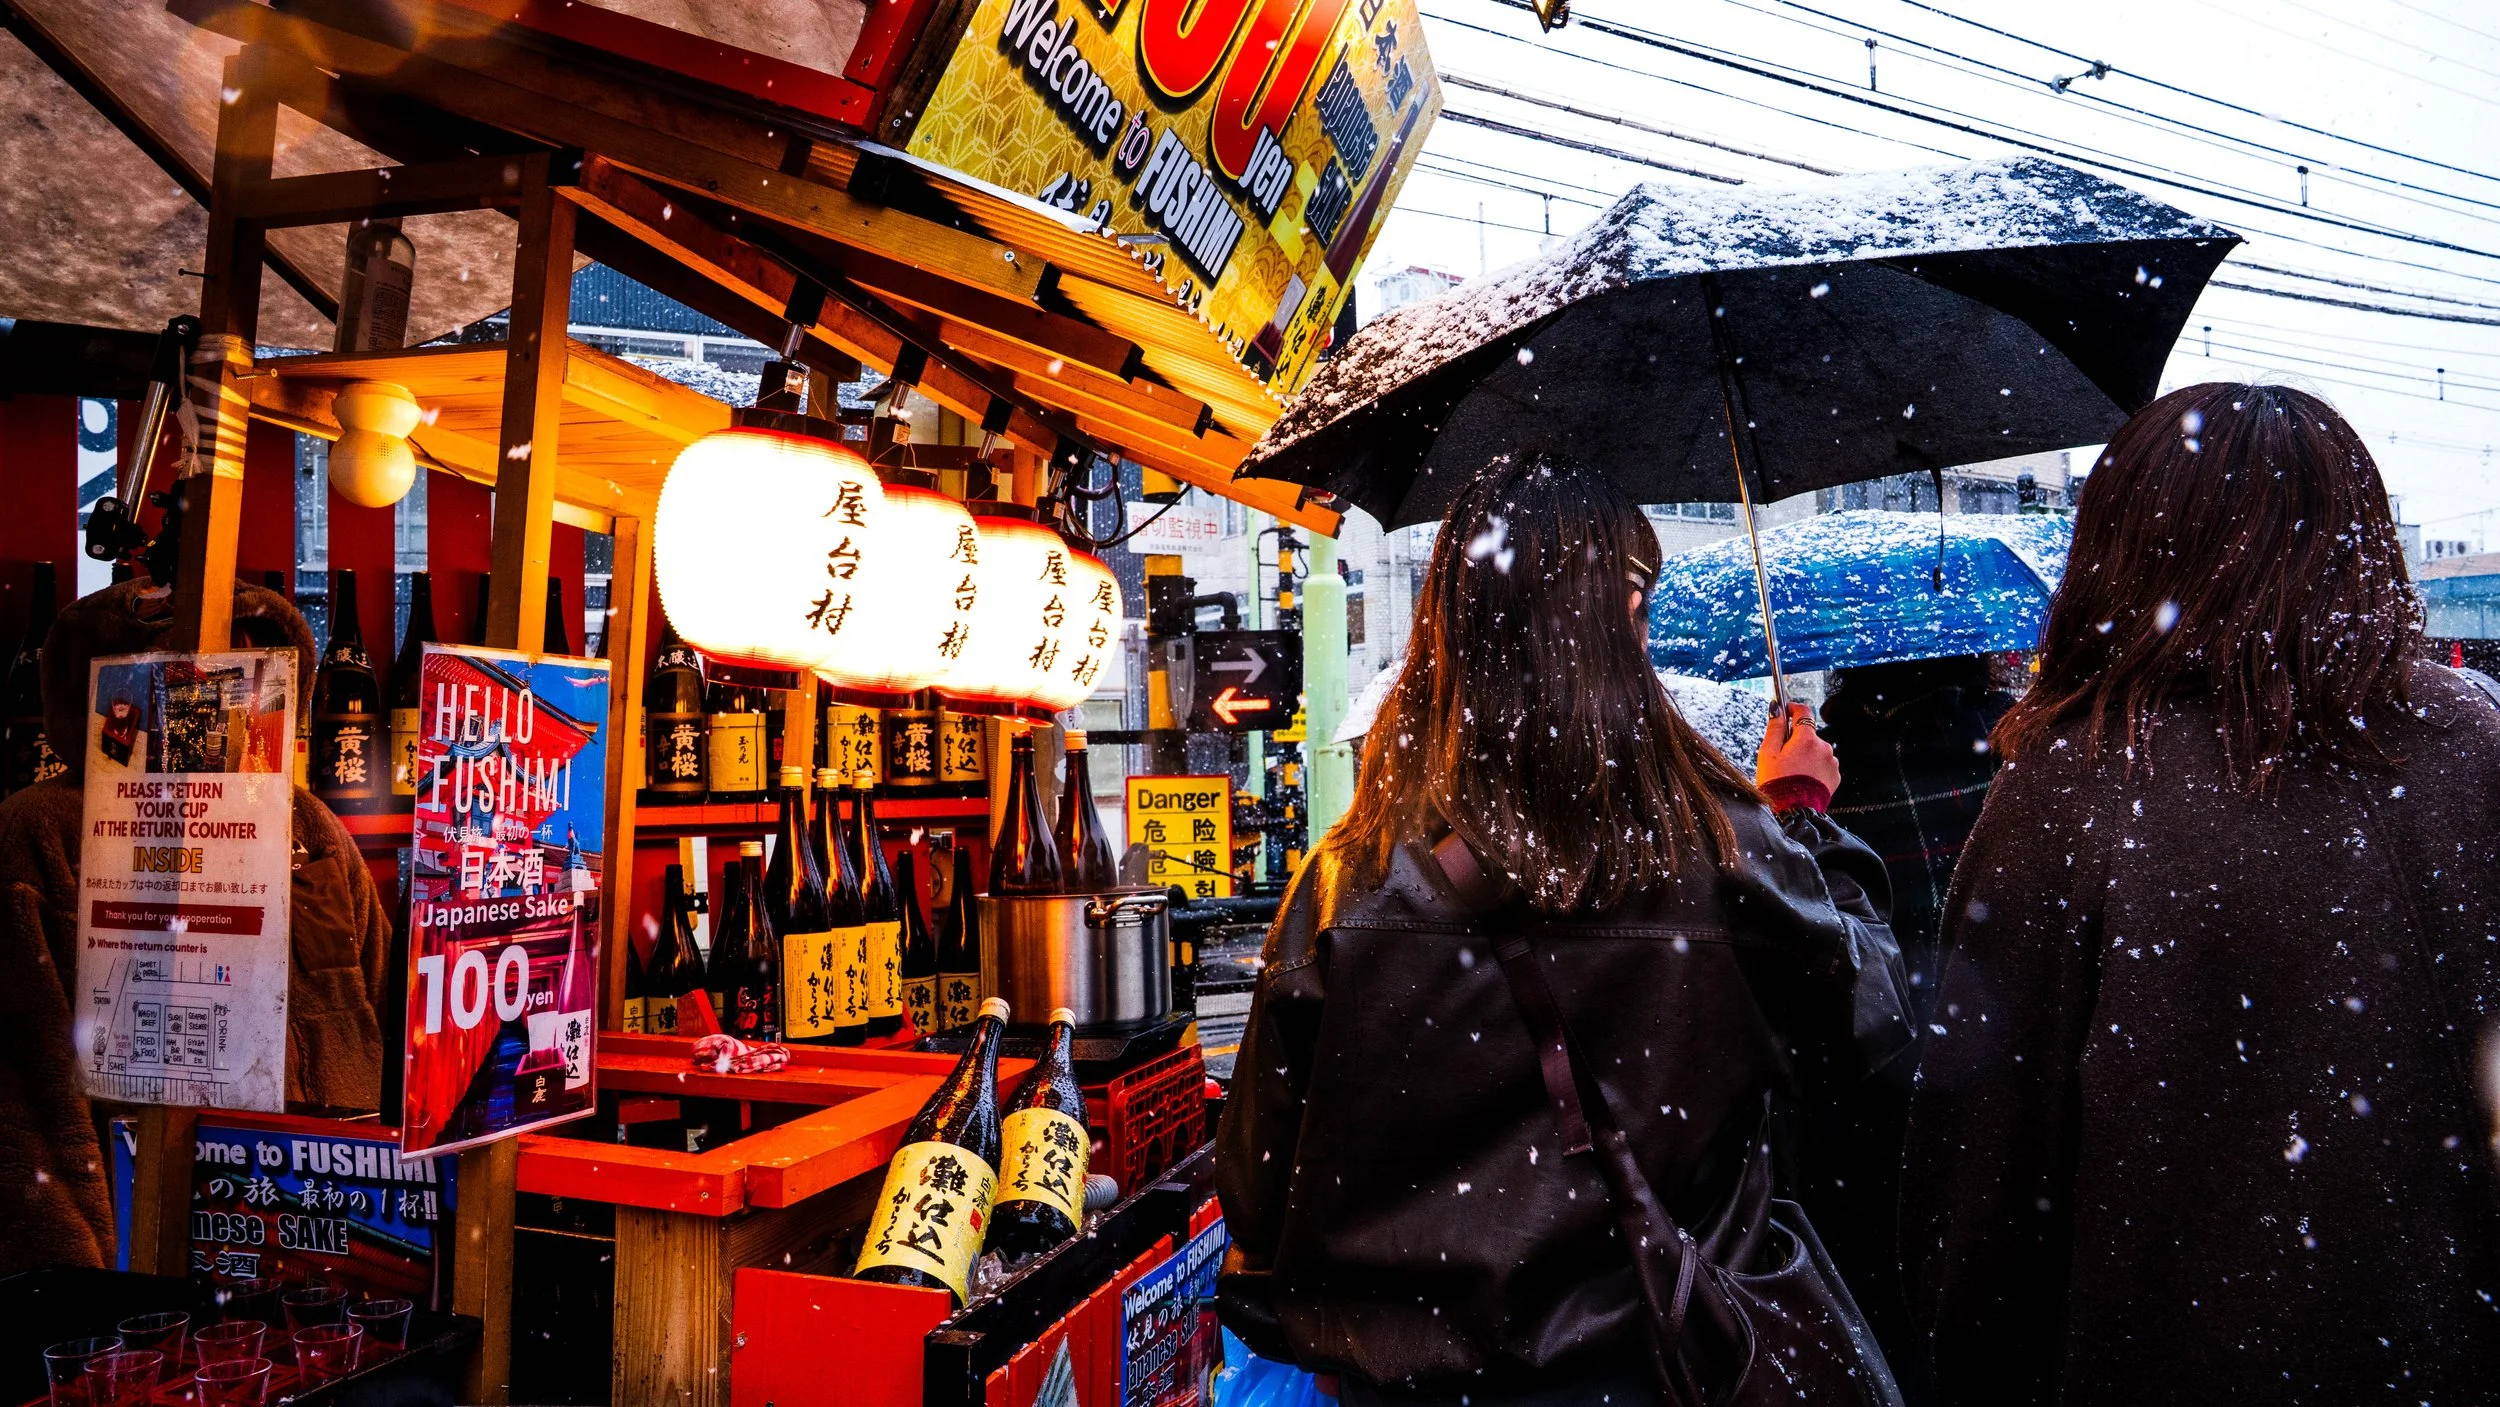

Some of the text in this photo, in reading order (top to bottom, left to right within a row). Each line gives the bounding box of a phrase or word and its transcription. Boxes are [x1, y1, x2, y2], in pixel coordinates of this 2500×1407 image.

[1004, 0, 1122, 143] Welcome
[1118, 110, 1150, 169] to
[1135, 127, 1244, 279] FUSHIMI
[1238, 125, 1293, 215] yen
[805, 480, 867, 635] 屋台村
[937, 524, 979, 660] 屋台村
[1028, 550, 1067, 672] 屋台村
[1071, 580, 1115, 686] 屋台村
[435, 682, 534, 744] HELLO
[334, 726, 370, 785] 黄桜
[670, 724, 700, 778] 黄桜
[738, 735, 750, 765] 玉乃光
[840, 735, 851, 778] からくち
[904, 722, 933, 773] 黄桜
[943, 733, 954, 775] からくち
[117, 782, 223, 799] PLEASE RETURN
[136, 802, 209, 818] YOUR CUP
[431, 755, 571, 814] FUSHIMI
[1138, 789, 1220, 812] Danger
[93, 821, 257, 840] AT THE RETURN COUNTER
[495, 824, 553, 842] 最初の一杯
[132, 847, 204, 873] INSIDE
[460, 848, 545, 893] 日本酒
[105, 910, 232, 926] Thank you for your cooperation
[418, 896, 568, 931] Japanese Sake
[97, 938, 208, 953] Where the return counter is
[418, 944, 554, 1035] 100 yen
[807, 971, 821, 1029] からくち
[845, 963, 858, 1018] からくち
[884, 956, 896, 1009] からくち
[136, 1036, 155, 1046] FRIED
[142, 1019, 156, 1027] BEEF
[218, 1020, 227, 1052] DRINK
[565, 1018, 582, 1079] 灘仕込
[109, 1062, 125, 1071] SAKE
[141, 1048, 157, 1058] FOOD
[532, 1075, 547, 1104] 白鹿
[255, 1140, 283, 1167] to
[291, 1140, 438, 1184] FUSHIMI
[1011, 1140, 1039, 1192] からくち
[1034, 1120, 1080, 1209] 灘仕込
[278, 1213, 349, 1255] SAKE
[875, 1186, 911, 1256] からくち
[896, 1154, 969, 1266] 灘仕込
[1125, 1221, 1226, 1322] Welcome to FUSHIMI
[1126, 1328, 1177, 1396] Japanese
